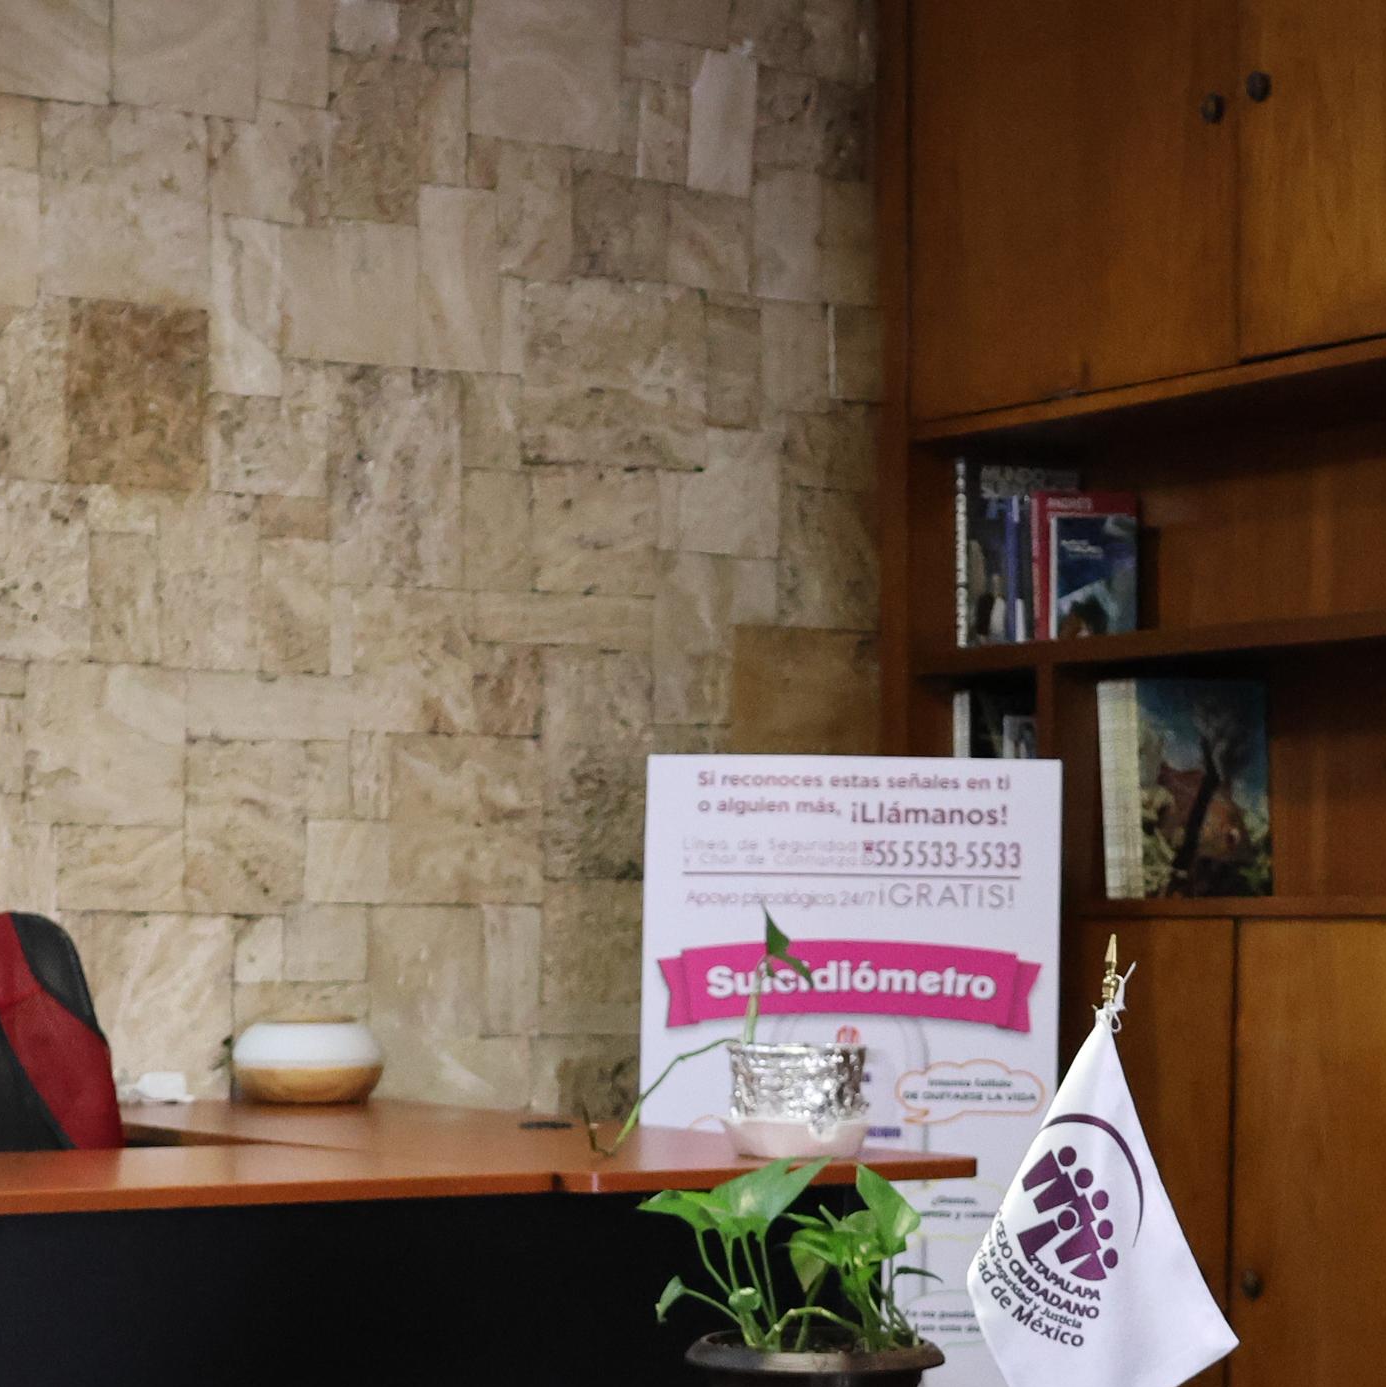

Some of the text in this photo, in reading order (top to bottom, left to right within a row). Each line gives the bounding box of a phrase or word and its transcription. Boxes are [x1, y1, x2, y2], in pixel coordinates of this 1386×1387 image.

[698, 771, 1011, 791] Si reconoces estas señales en ti
[697, 797, 1008, 826] o alguien más, ¡Llámanos!
[878, 882, 1015, 910] ¡GRATIS!
[706, 958, 998, 1001] Suicidiómetro
[1024, 1251, 1102, 1301] ZTAPALAPA
[990, 1286, 1012, 1311] de
[1011, 1303, 1085, 1348] México
[1040, 1307, 1083, 1329] Justicia
